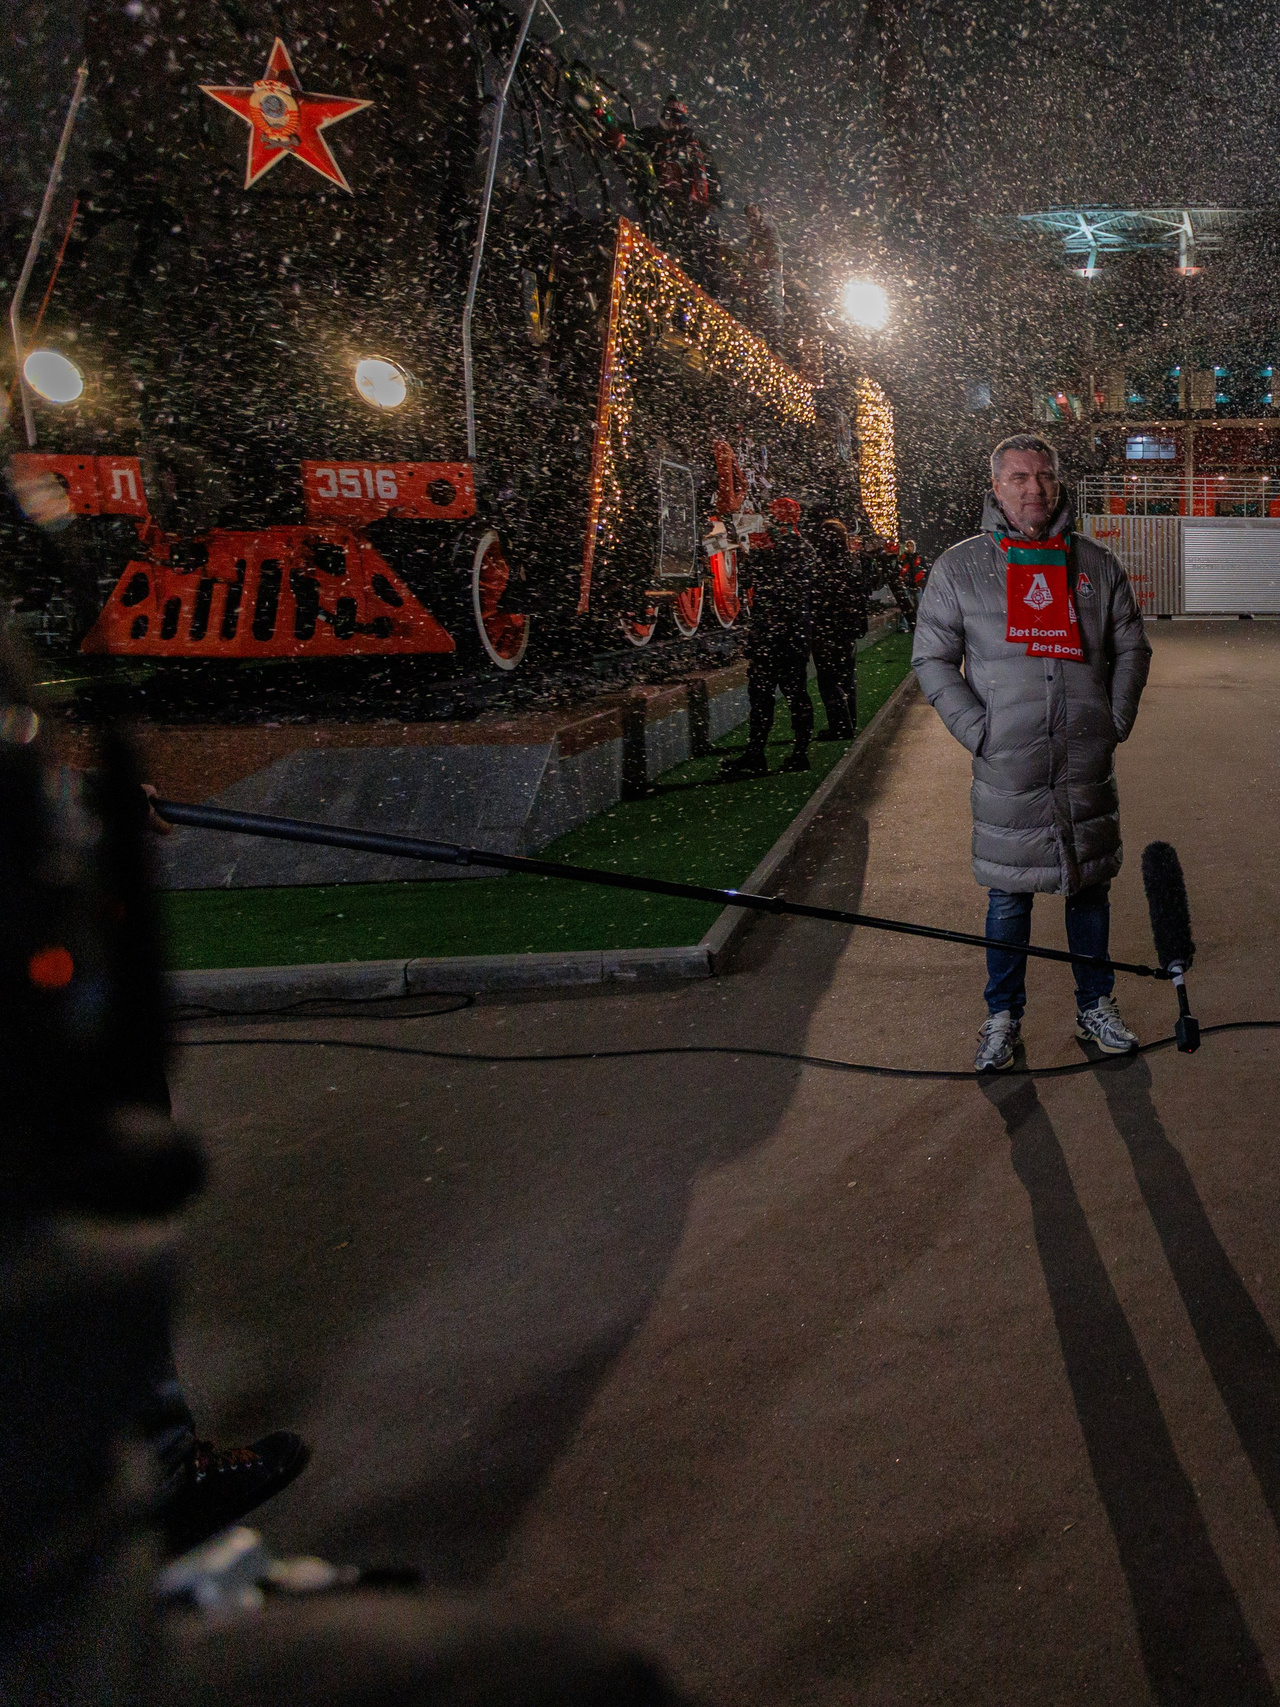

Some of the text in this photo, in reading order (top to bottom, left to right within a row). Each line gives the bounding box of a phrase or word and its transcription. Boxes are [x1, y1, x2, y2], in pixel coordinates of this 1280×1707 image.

[112, 470, 138, 499] Л
[315, 468, 398, 498] 3516
[1009, 626, 1067, 637] BetBoom
